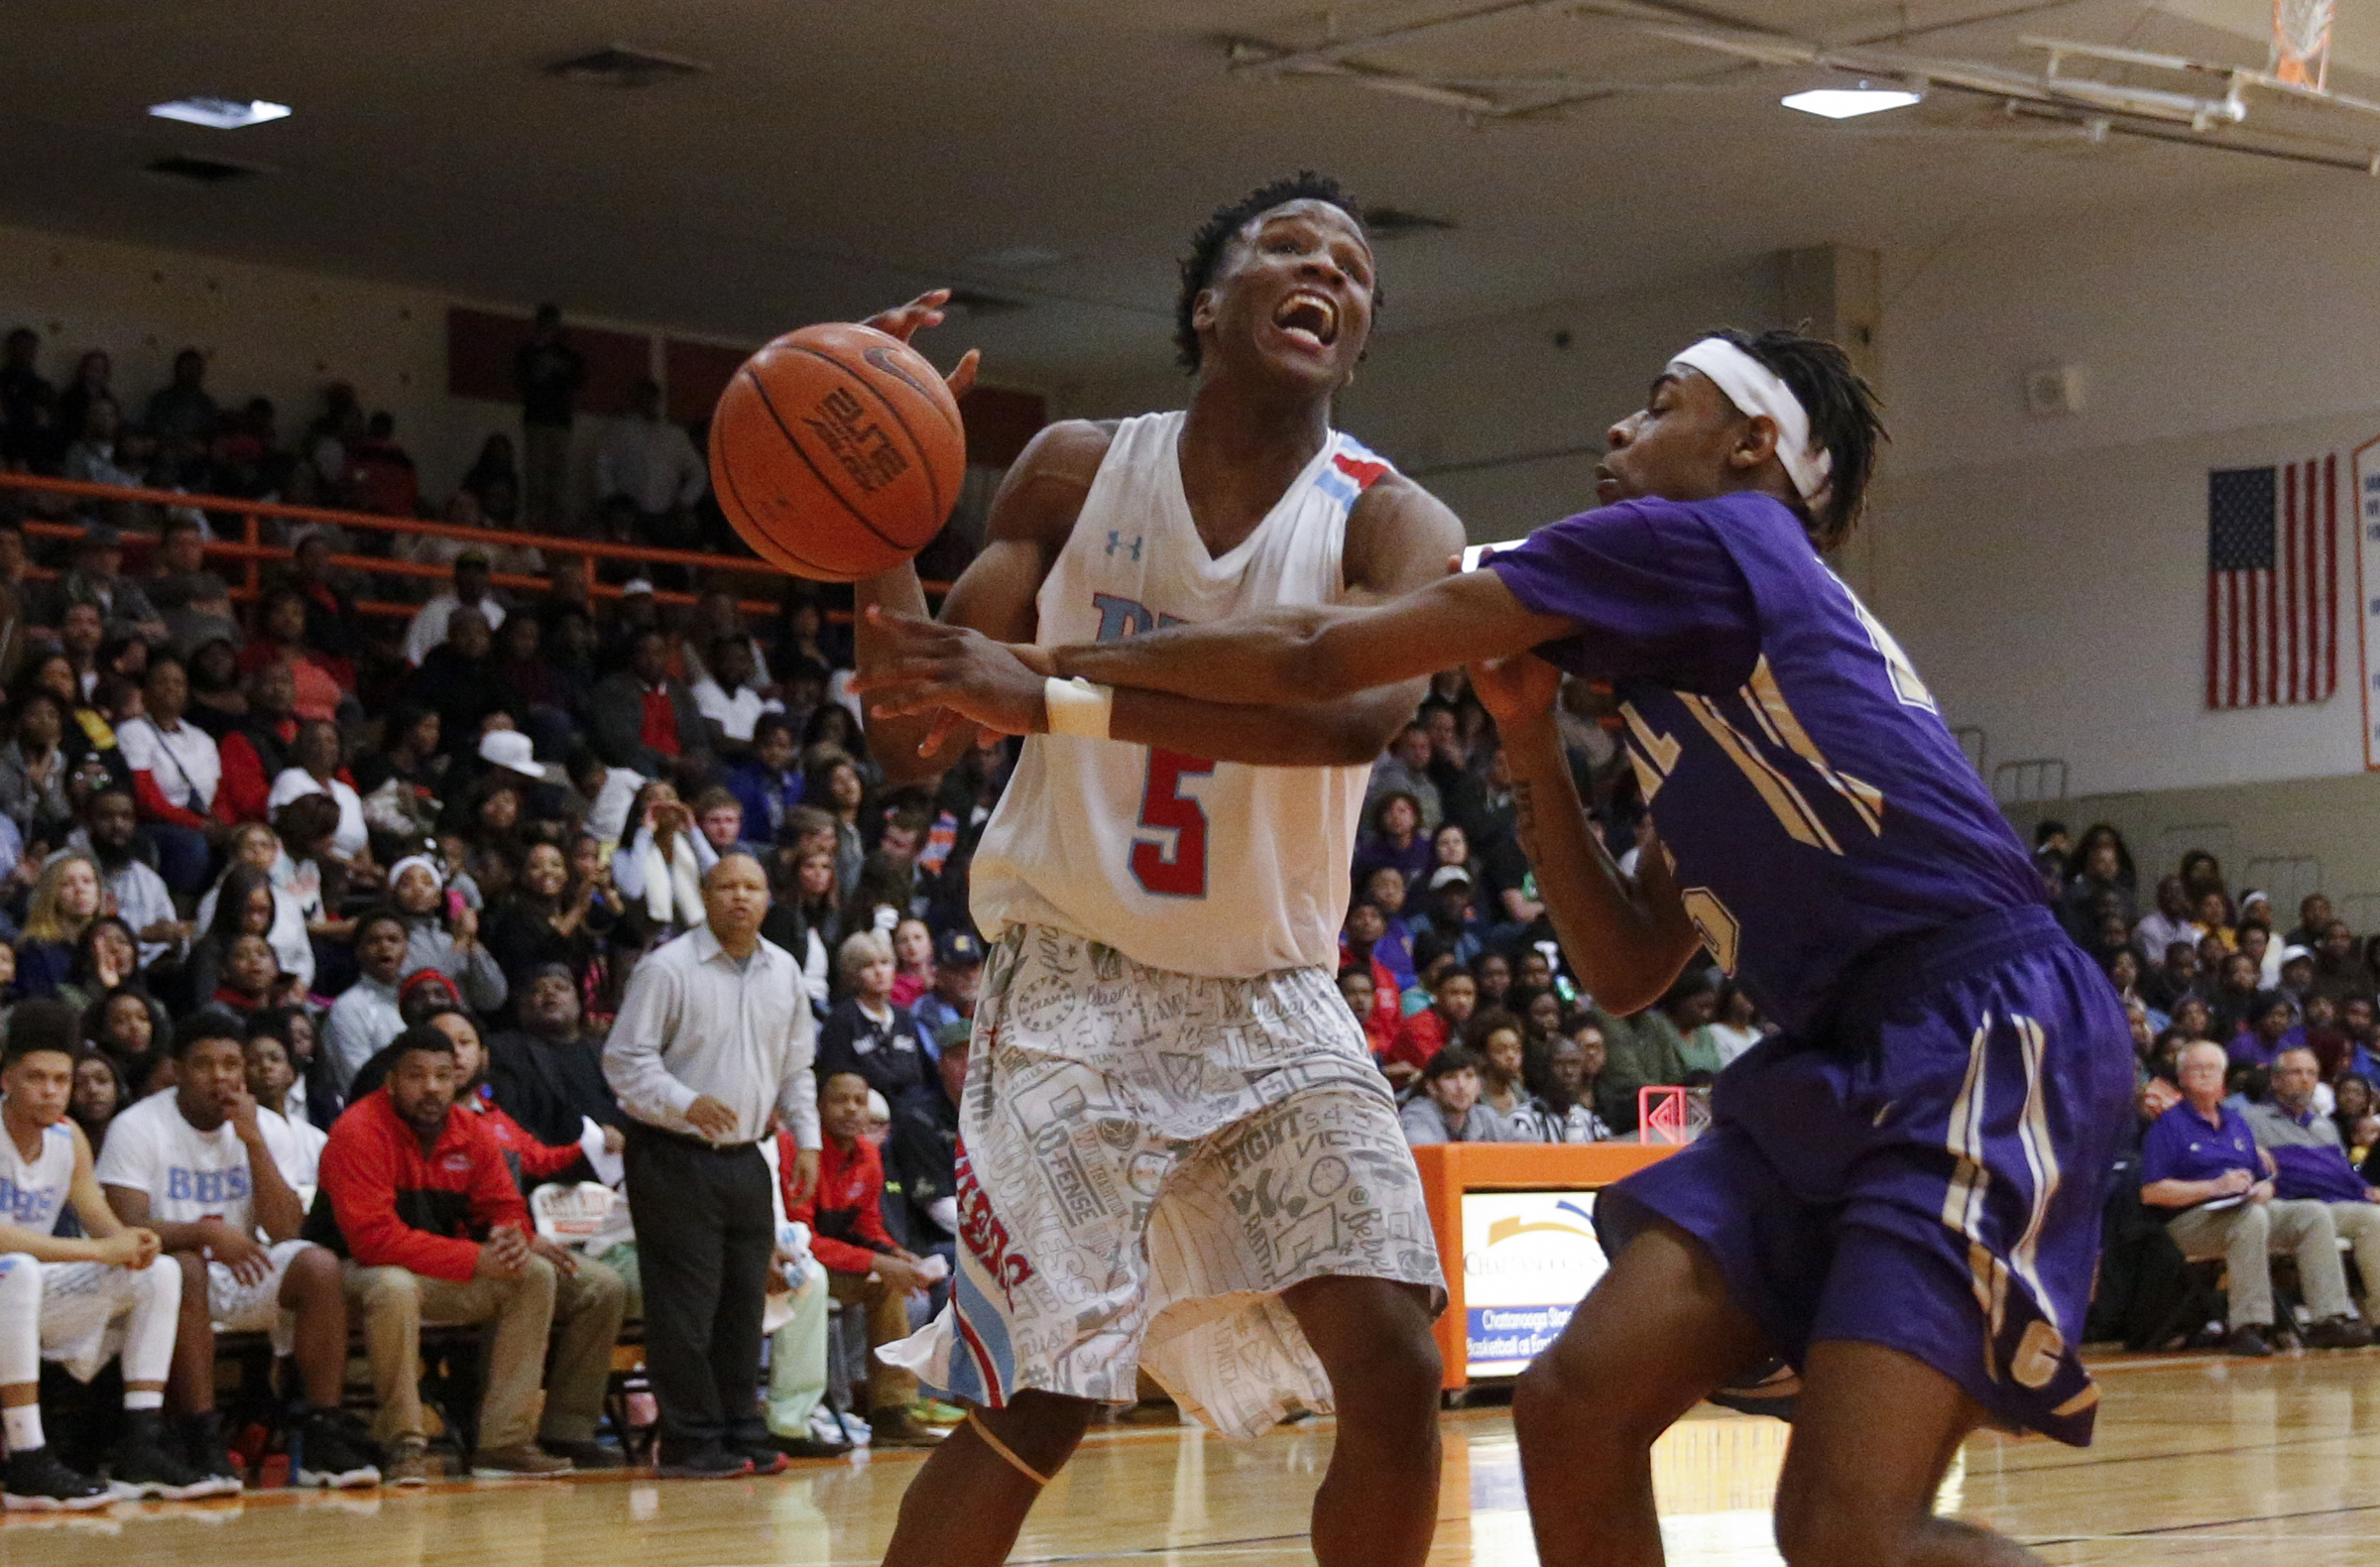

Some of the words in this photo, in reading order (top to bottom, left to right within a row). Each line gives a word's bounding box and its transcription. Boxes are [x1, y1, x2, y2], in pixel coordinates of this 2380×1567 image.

[1129, 745, 1217, 901] 5
[1221, 1106, 1302, 1180] FIGHT
[169, 1165, 247, 1203] BHS
[1483, 1309, 1547, 1333] Chattanooga
[1466, 1336, 1518, 1358] Basketball
